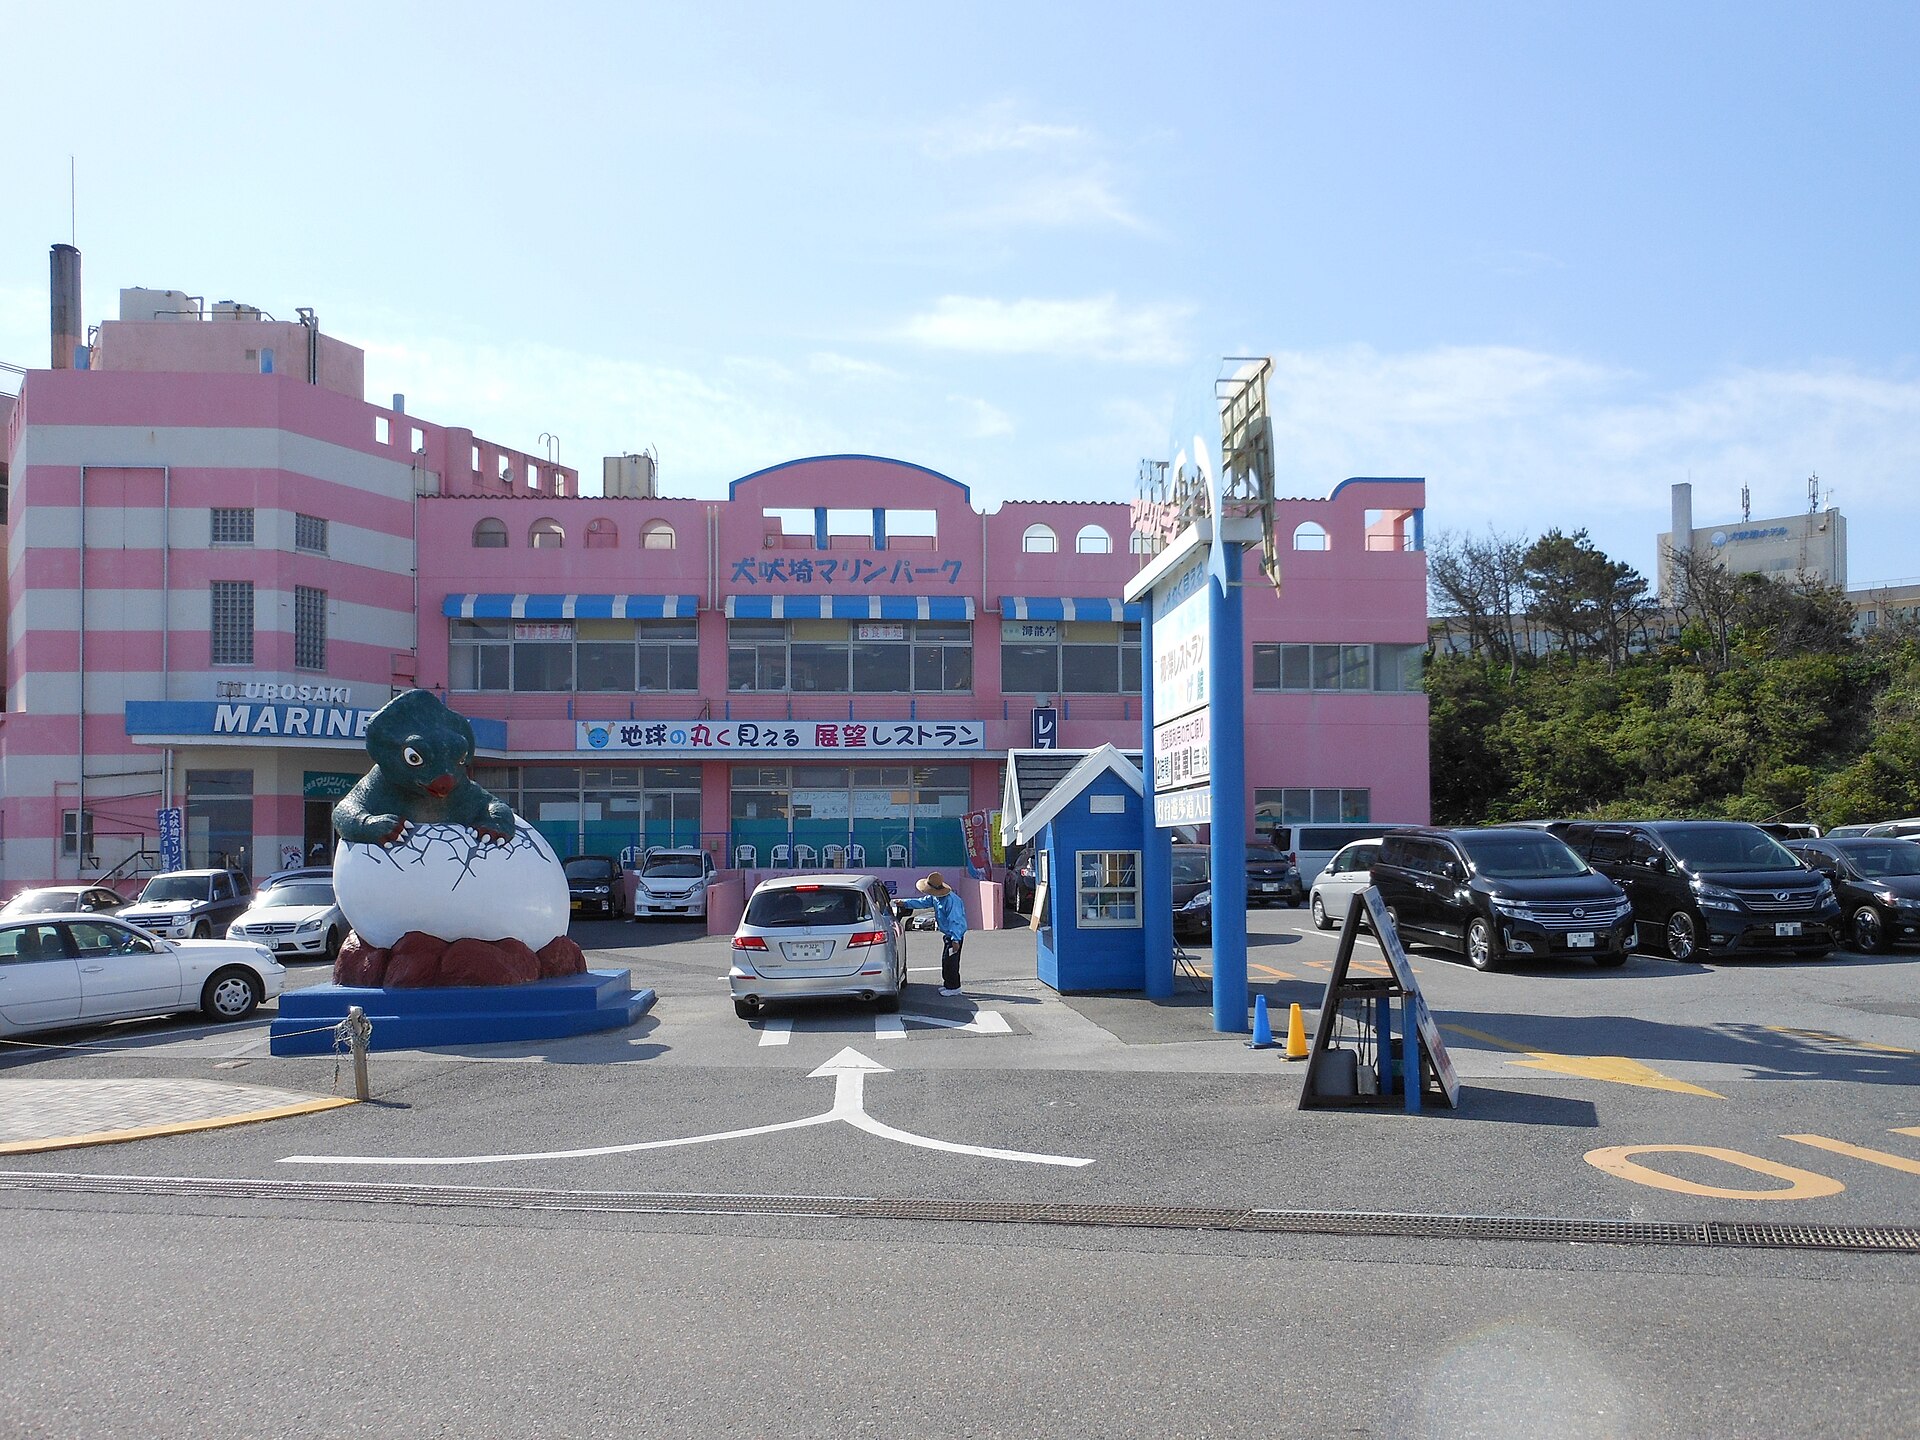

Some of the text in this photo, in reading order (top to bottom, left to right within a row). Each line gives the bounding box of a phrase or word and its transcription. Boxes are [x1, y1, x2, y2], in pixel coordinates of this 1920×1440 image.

[730, 558, 962, 585] 犬吠埼マリンパーク
